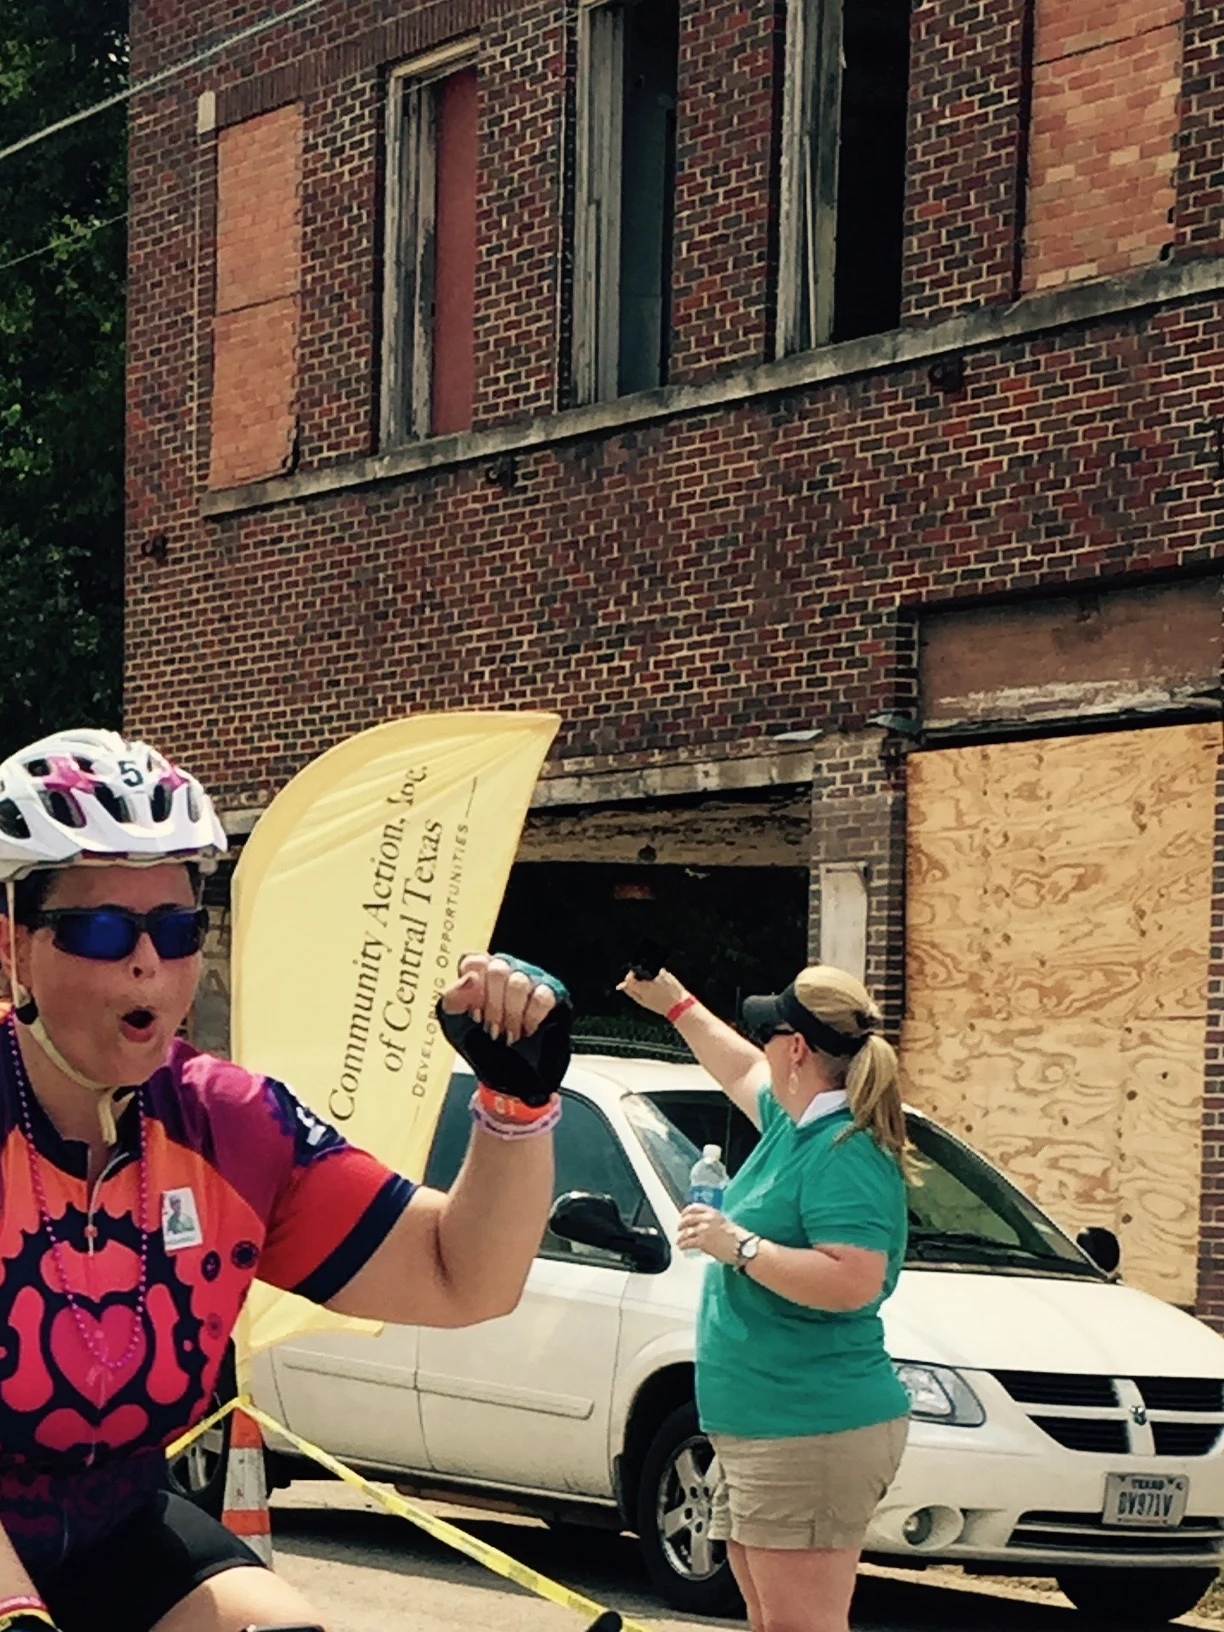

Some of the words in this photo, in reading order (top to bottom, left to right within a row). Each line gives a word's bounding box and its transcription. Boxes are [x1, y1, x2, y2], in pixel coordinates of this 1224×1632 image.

[118, 760, 143, 787] 5
[402, 819, 443, 906] Texas
[436, 823, 469, 969] OPPORTUNITIES
[328, 930, 393, 1121] Community
[362, 817, 406, 928] Action,
[382, 913, 428, 1032] Central
[378, 1032, 407, 1072] of
